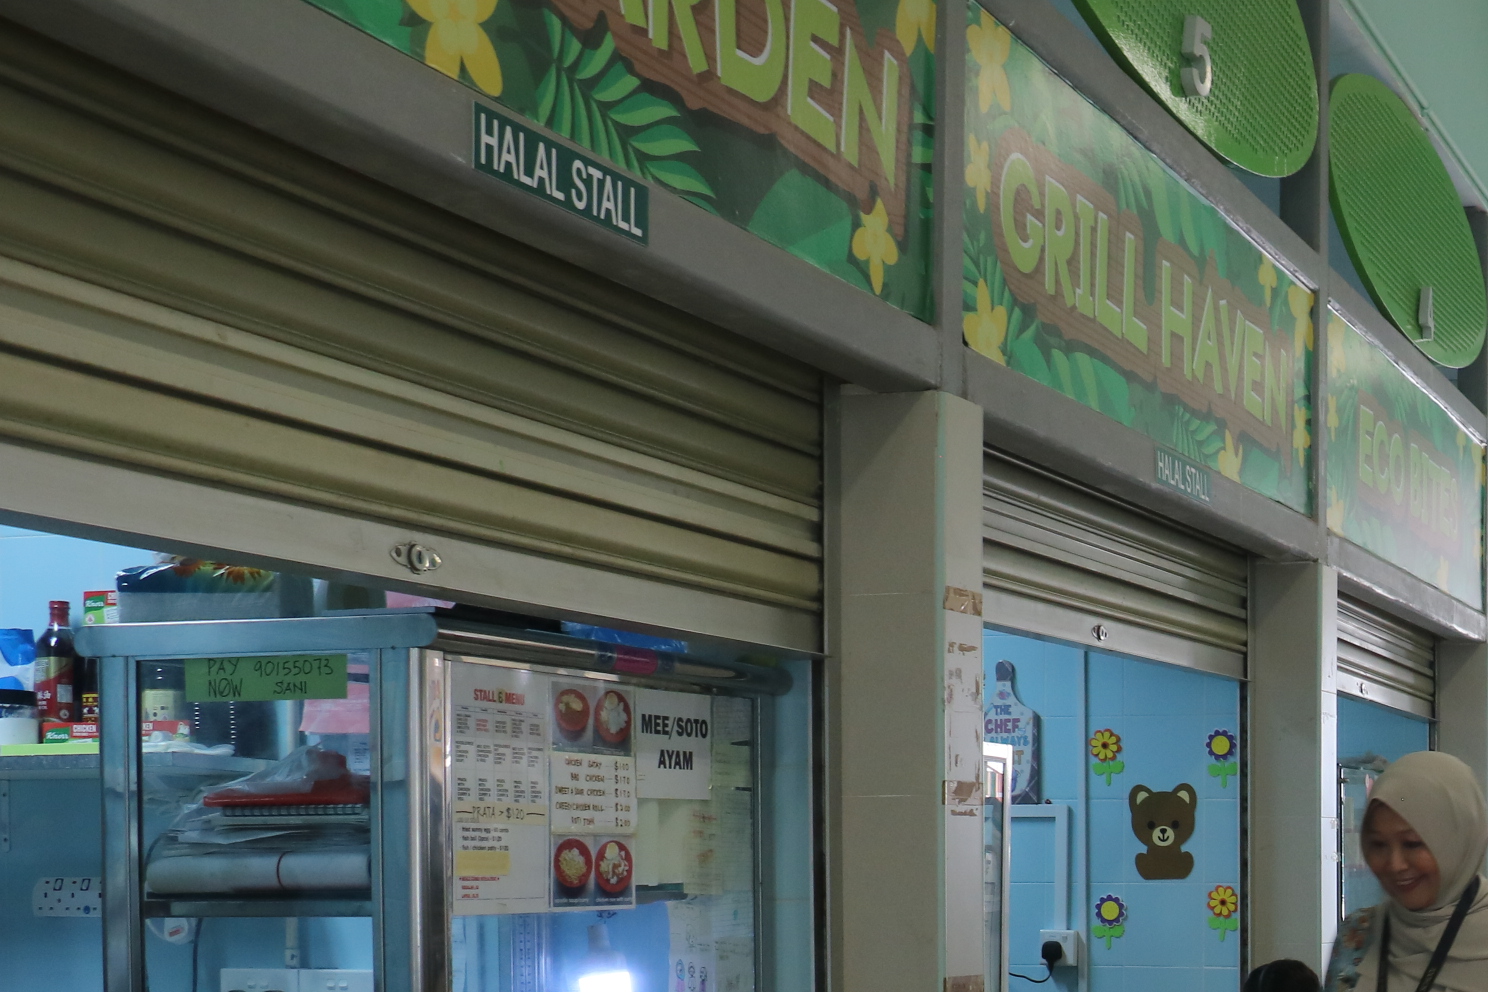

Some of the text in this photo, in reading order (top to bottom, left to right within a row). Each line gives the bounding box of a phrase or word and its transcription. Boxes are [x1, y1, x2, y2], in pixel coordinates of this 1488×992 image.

[1181, 14, 1212, 96] 5
[480, 112, 643, 237] HALAL STALL
[1001, 152, 1288, 435] GRILL HAVEN
[1359, 404, 1405, 505] ECO
[1157, 450, 1210, 502] HALAL STALL
[208, 658, 334, 676] PAY 90155073
[273, 680, 307, 695] SANI
[474, 689, 496, 702] STALL
[505, 692, 525, 705] MENU
[993, 705, 1011, 715] THE
[641, 713, 708, 740] MEE/SOTO
[985, 718, 1020, 734] CHEF
[658, 749, 694, 770] AYAM
[472, 806, 496, 818] PRATA
